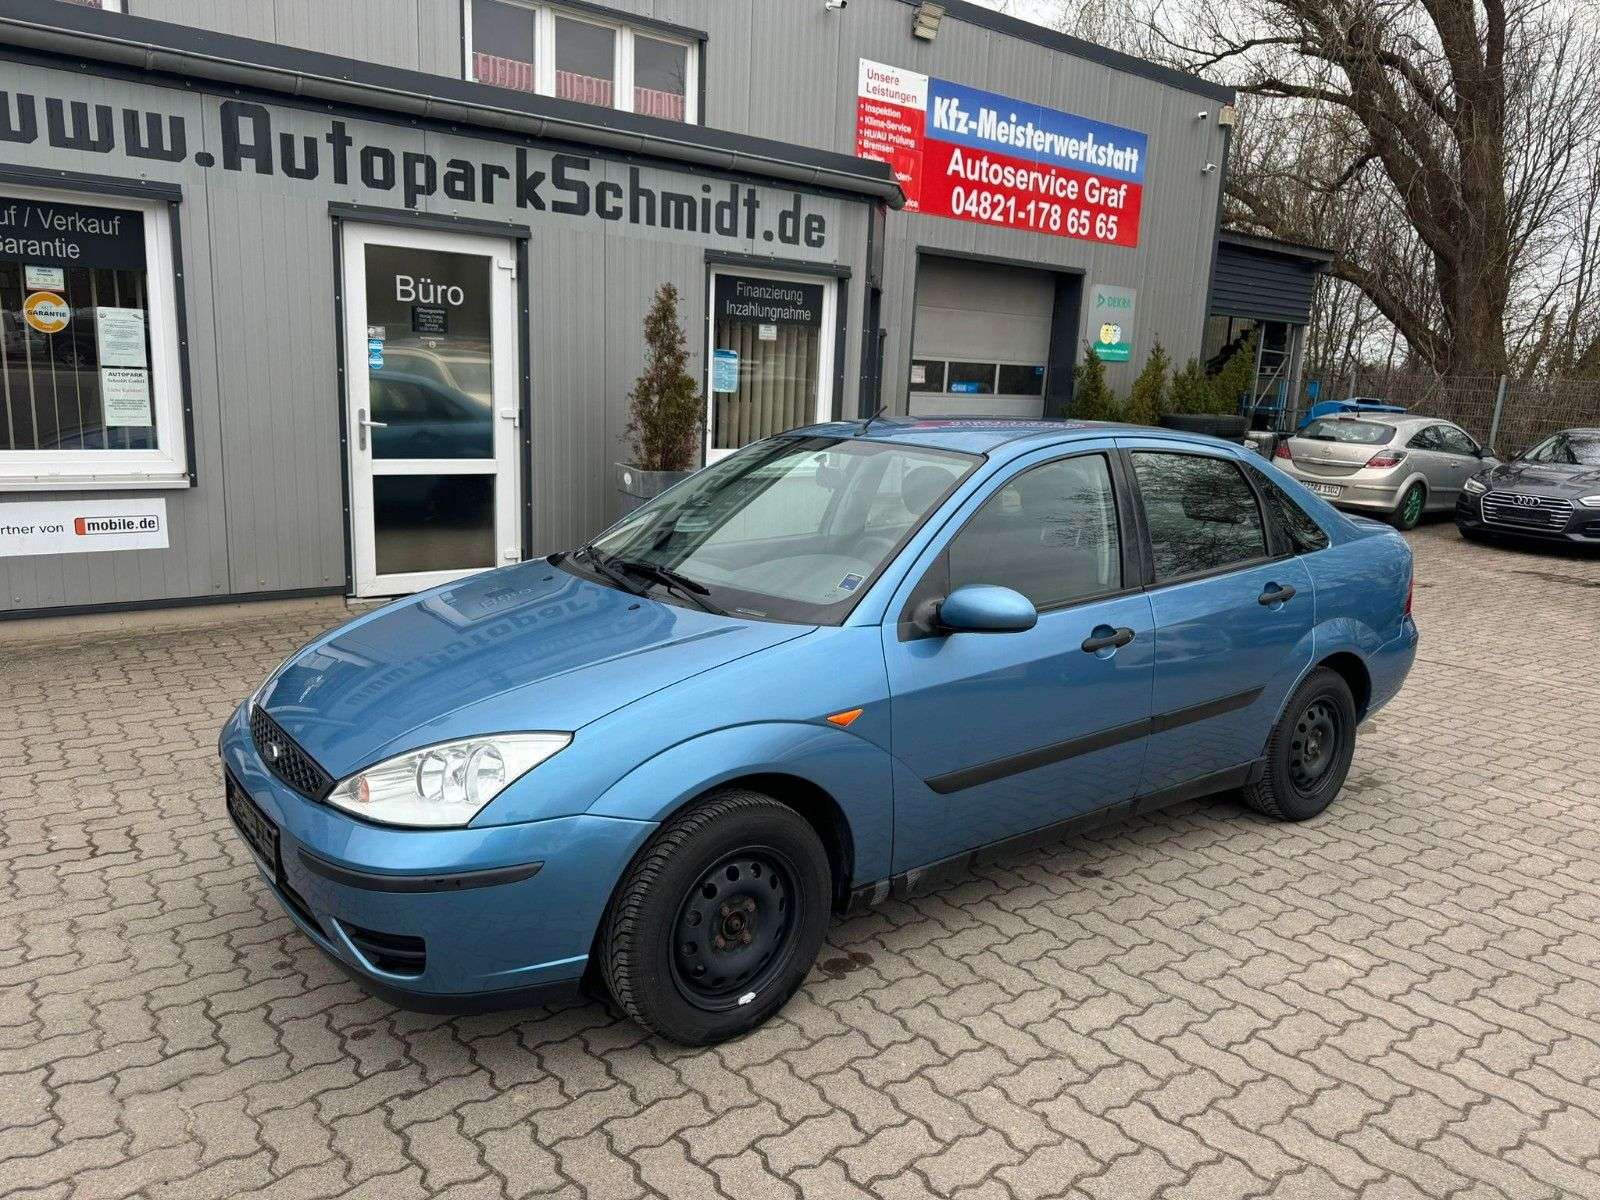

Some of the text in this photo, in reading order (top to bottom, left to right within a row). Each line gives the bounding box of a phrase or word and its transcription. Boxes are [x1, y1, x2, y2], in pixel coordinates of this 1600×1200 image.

[867, 69, 900, 86] Unsere
[866, 82, 917, 104] Leistungen
[864, 103, 902, 119] Inspektion
[888, 134, 915, 149] Prüfung
[934, 96, 1139, 173] Kfz-Meisterwerkstatt
[863, 139, 895, 154] Bremsen
[946, 148, 1128, 209] Autoservice Graf
[37, 207, 121, 236] Verkauf
[952, 186, 1119, 241] 04821-178 65 65
[396, 274, 465, 306] Büro
[736, 281, 804, 304] Finanzierung
[27, 309, 67, 318] GARANTIE
[726, 300, 812, 322] Inzahlungnahme
[39, 525, 64, 533] von
[87, 518, 156, 531] mobile.de
